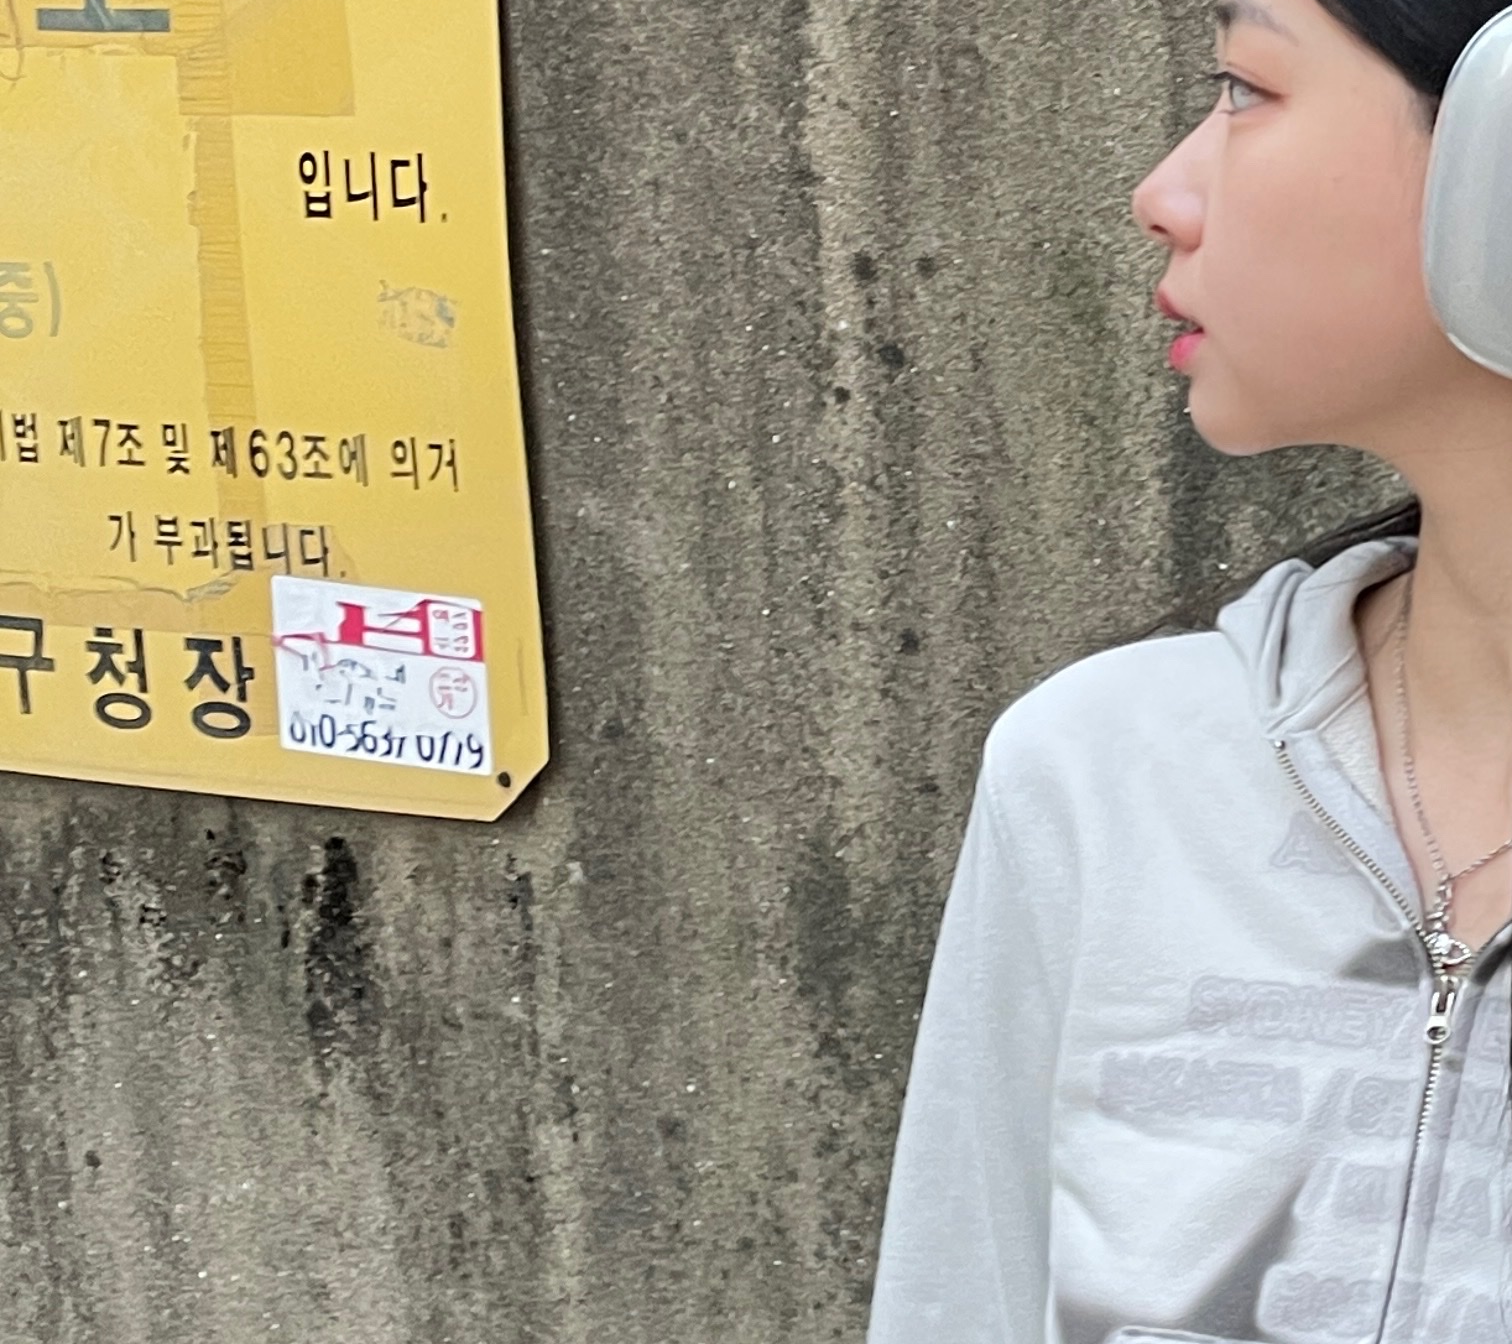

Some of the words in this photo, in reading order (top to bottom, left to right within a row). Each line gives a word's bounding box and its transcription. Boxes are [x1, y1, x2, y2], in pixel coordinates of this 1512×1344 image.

[298, 148, 448, 224] 입니다.
[0, 408, 39, 464] 법
[57, 415, 146, 468] 제7조
[161, 422, 191, 475] 및
[210, 425, 370, 487] 제63조에
[390, 436, 461, 492] 의거
[107, 510, 137, 563] 가
[154, 513, 347, 578] 부과됩니다.
